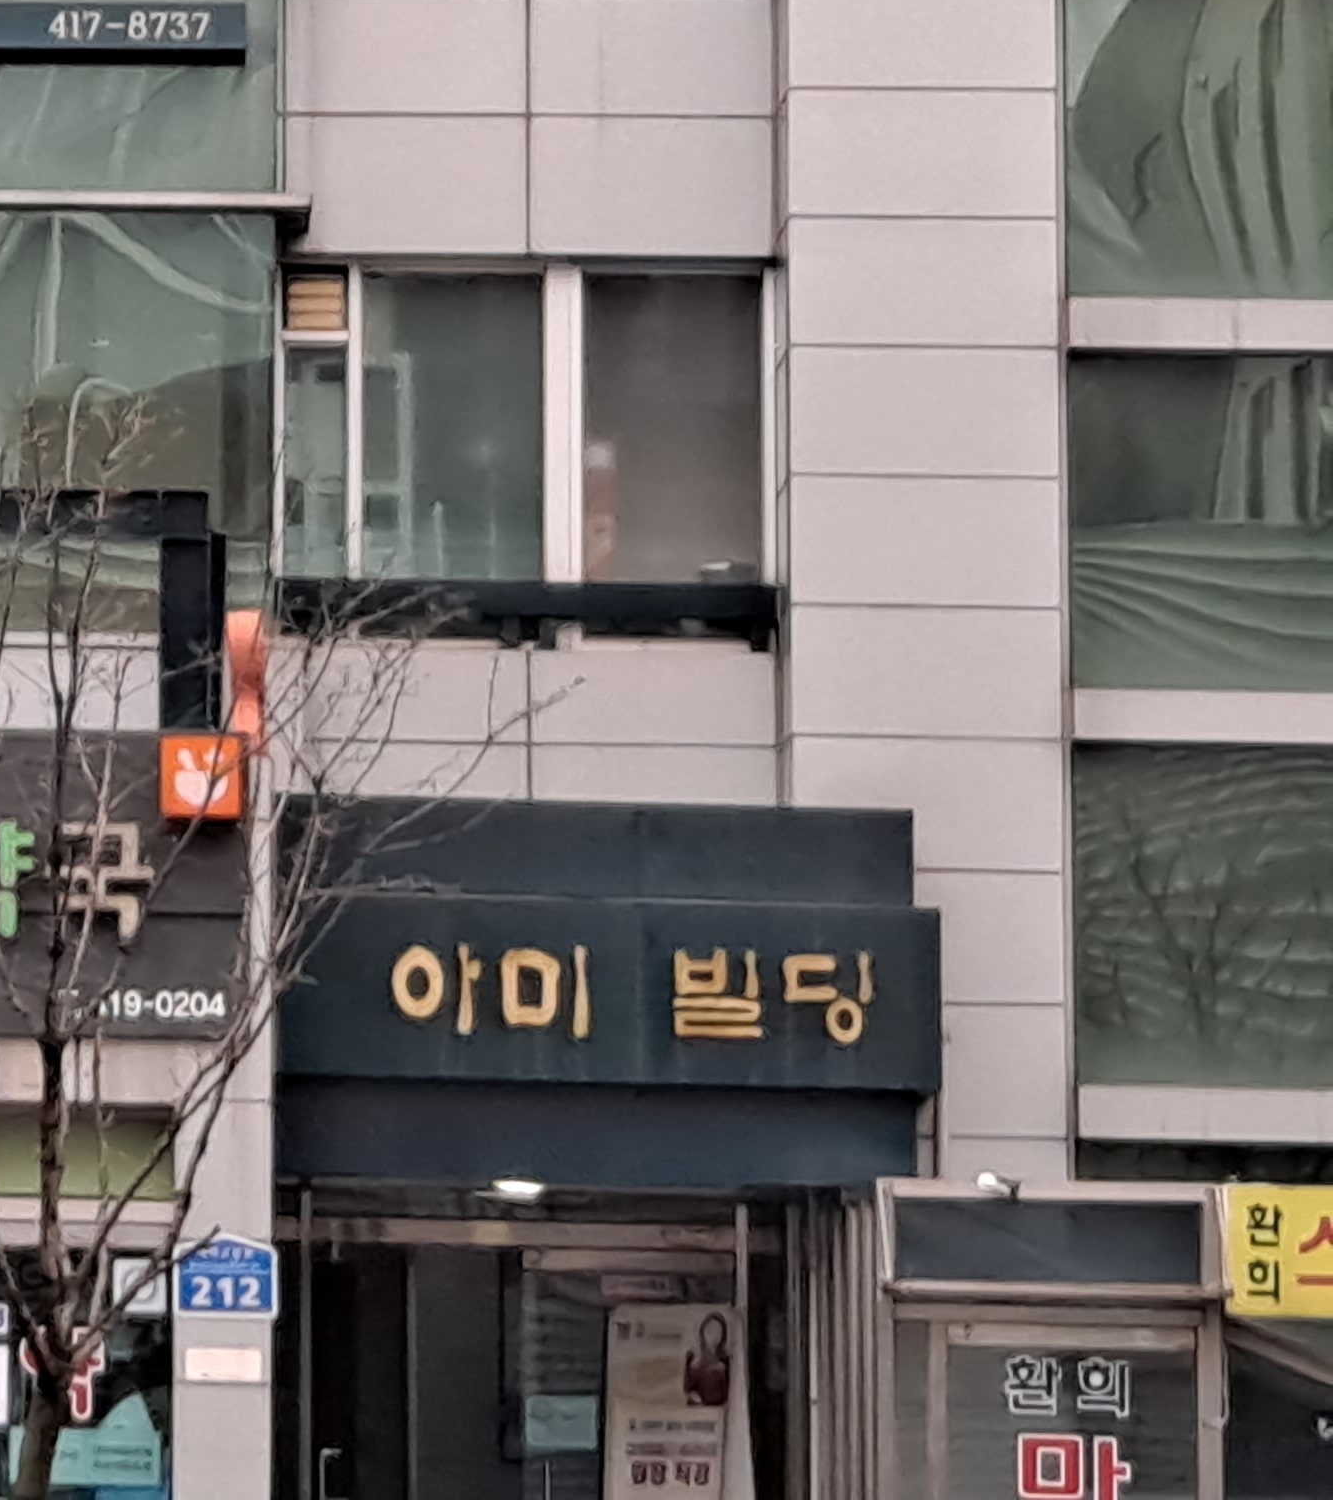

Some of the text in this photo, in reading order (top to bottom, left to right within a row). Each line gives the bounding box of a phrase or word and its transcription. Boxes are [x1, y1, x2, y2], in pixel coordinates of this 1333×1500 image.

[48, 11, 211, 41] 417-8737
[390, 943, 874, 1046] 아미 빌딩
[190, 1275, 262, 1308] 212
